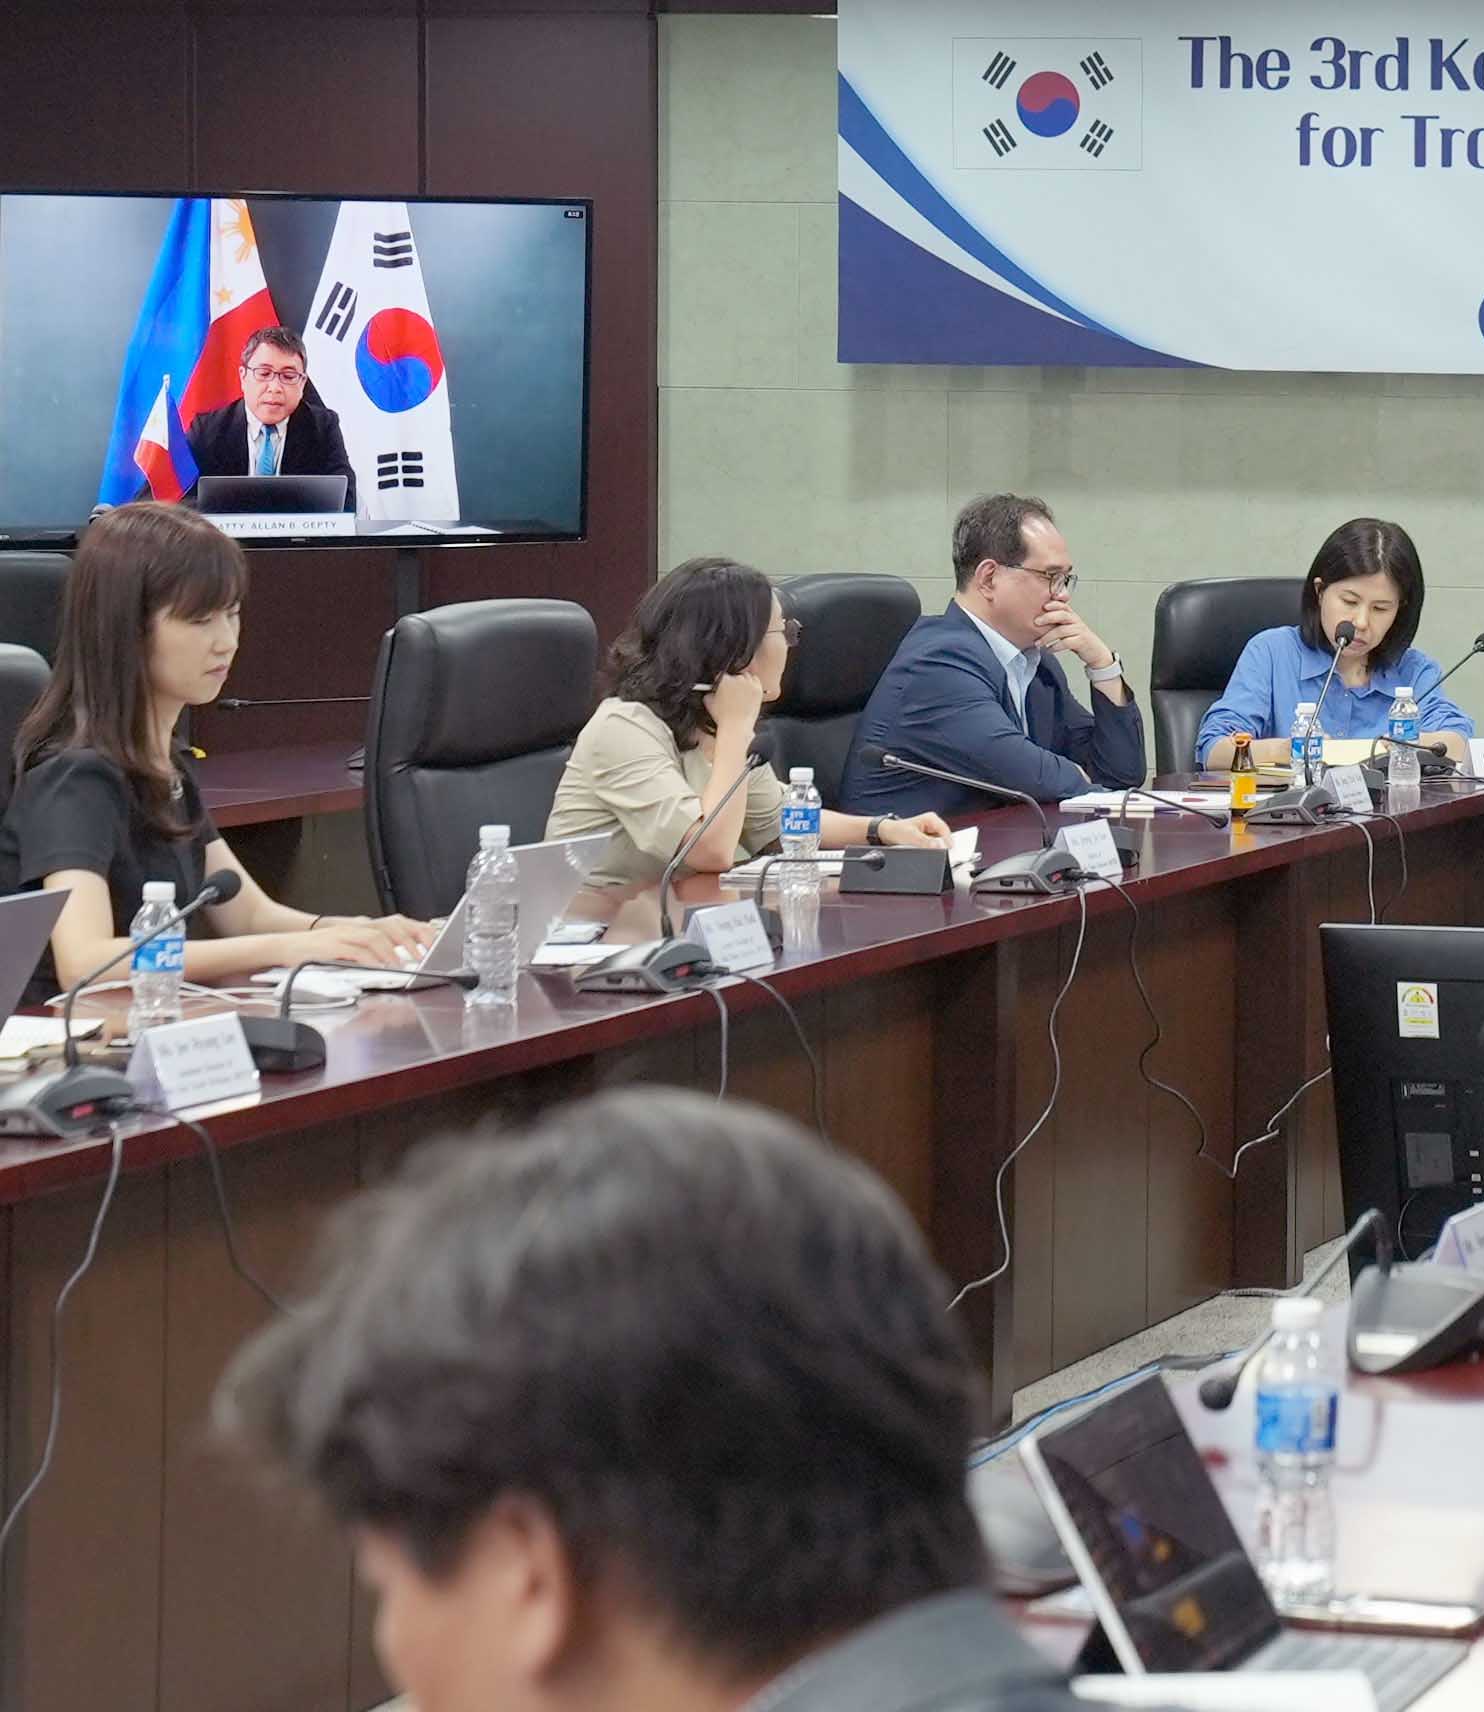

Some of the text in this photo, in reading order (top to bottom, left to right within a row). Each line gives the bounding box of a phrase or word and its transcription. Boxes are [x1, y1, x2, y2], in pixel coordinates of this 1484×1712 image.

[1178, 35, 1290, 91] The
[1309, 36, 1410, 92] 3rd
[1296, 112, 1385, 168] for
